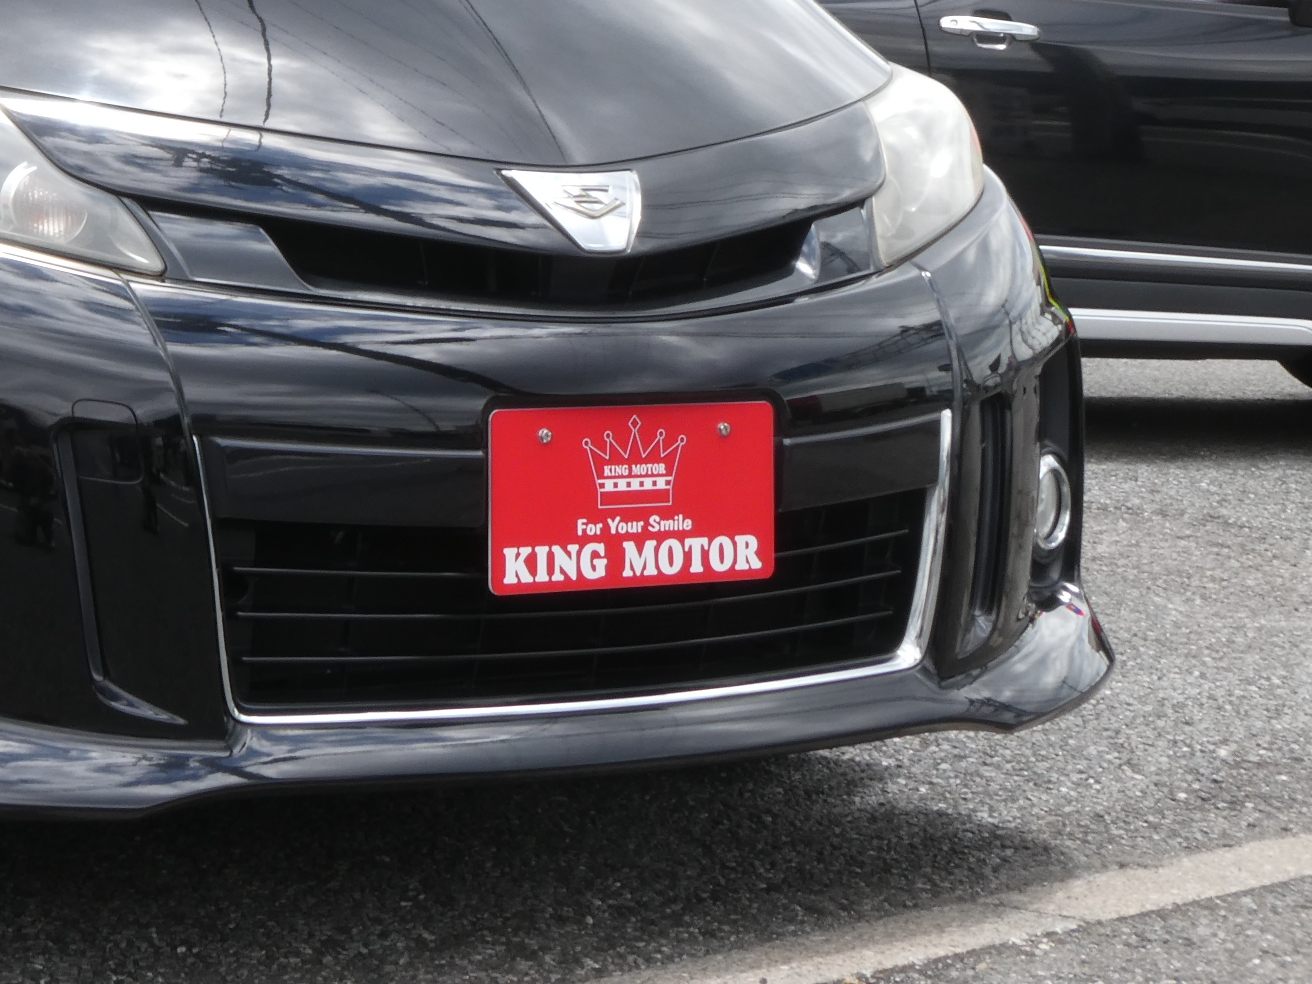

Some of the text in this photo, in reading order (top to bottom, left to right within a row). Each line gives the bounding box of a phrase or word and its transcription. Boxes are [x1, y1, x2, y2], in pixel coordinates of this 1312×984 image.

[603, 463, 666, 476] KING MOTOR
[577, 514, 692, 536] For Your Smile
[503, 534, 762, 585] KING MOTOR
